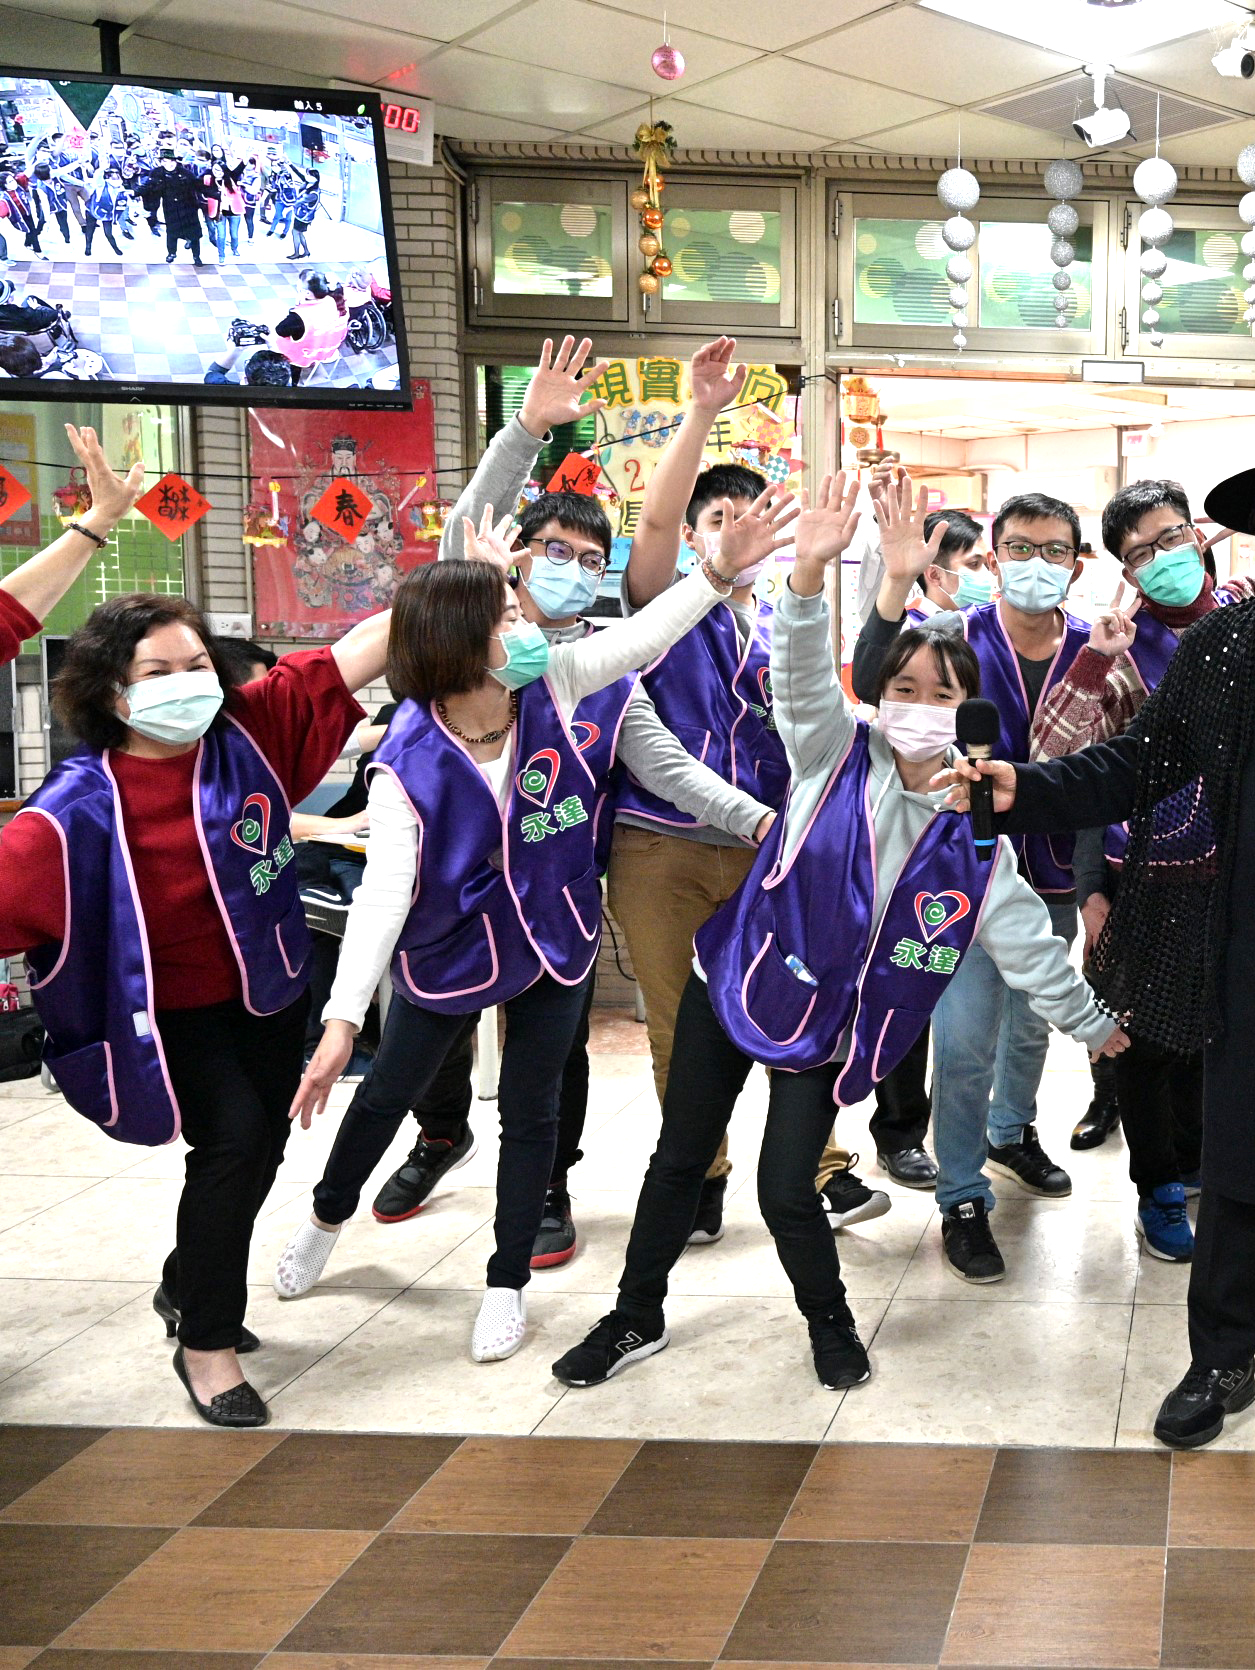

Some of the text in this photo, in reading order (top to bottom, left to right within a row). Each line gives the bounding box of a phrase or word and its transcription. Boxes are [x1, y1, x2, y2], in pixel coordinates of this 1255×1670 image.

[381, 103, 420, 132] 00
[588, 359, 784, 412] 現實向
[333, 488, 363, 527] 春
[520, 794, 588, 842] 永達
[249, 834, 295, 895] 永達
[889, 937, 961, 974] 永達
